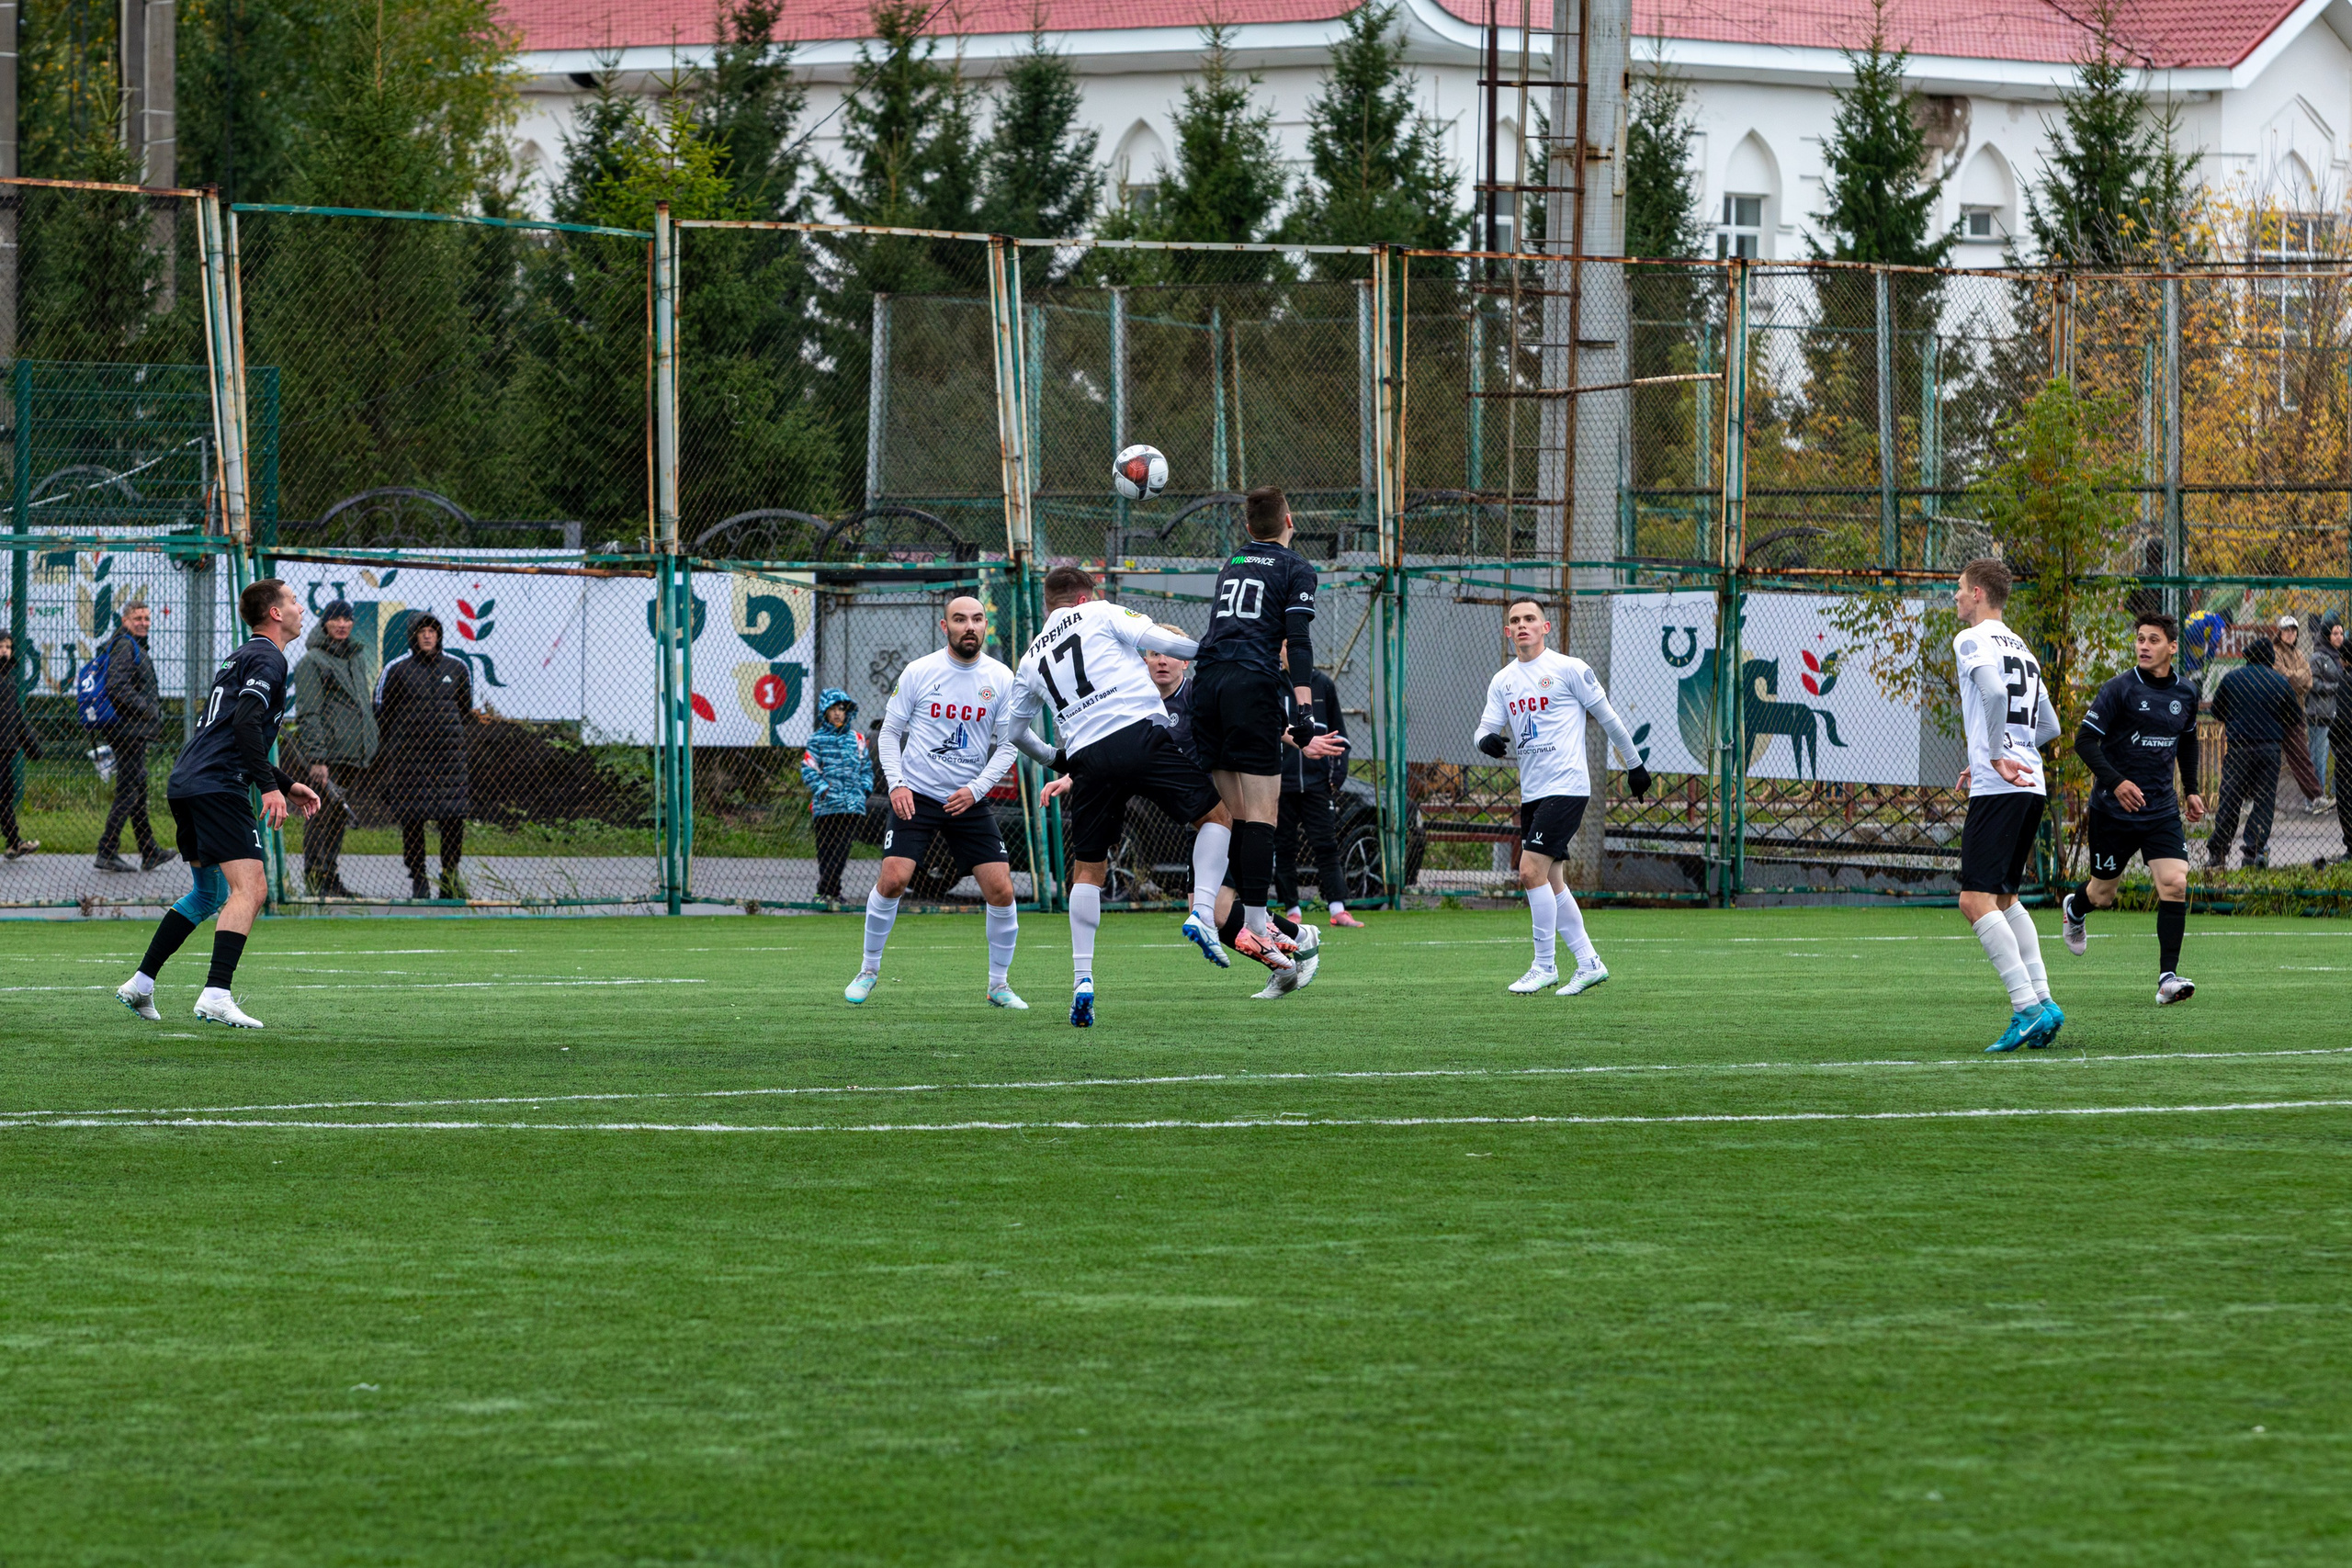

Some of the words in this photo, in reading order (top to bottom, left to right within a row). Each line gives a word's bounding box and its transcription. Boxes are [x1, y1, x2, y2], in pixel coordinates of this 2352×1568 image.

[1231, 556, 1275, 566] VINSERVICE
[1216, 578, 1265, 619] 90
[1029, 613, 1082, 658] ТУРБИНА
[1037, 633, 1095, 712] 17
[1082, 698, 1095, 709] АКЗ
[1094, 686, 1118, 702] Гарант
[2003, 655, 2041, 729] 27
[931, 703, 986, 722] СССР
[1510, 696, 1549, 716] СССР
[927, 752, 980, 764] АВТОСТОЛИЦА
[884, 829, 894, 850] 8
[2095, 852, 2117, 871] 14
